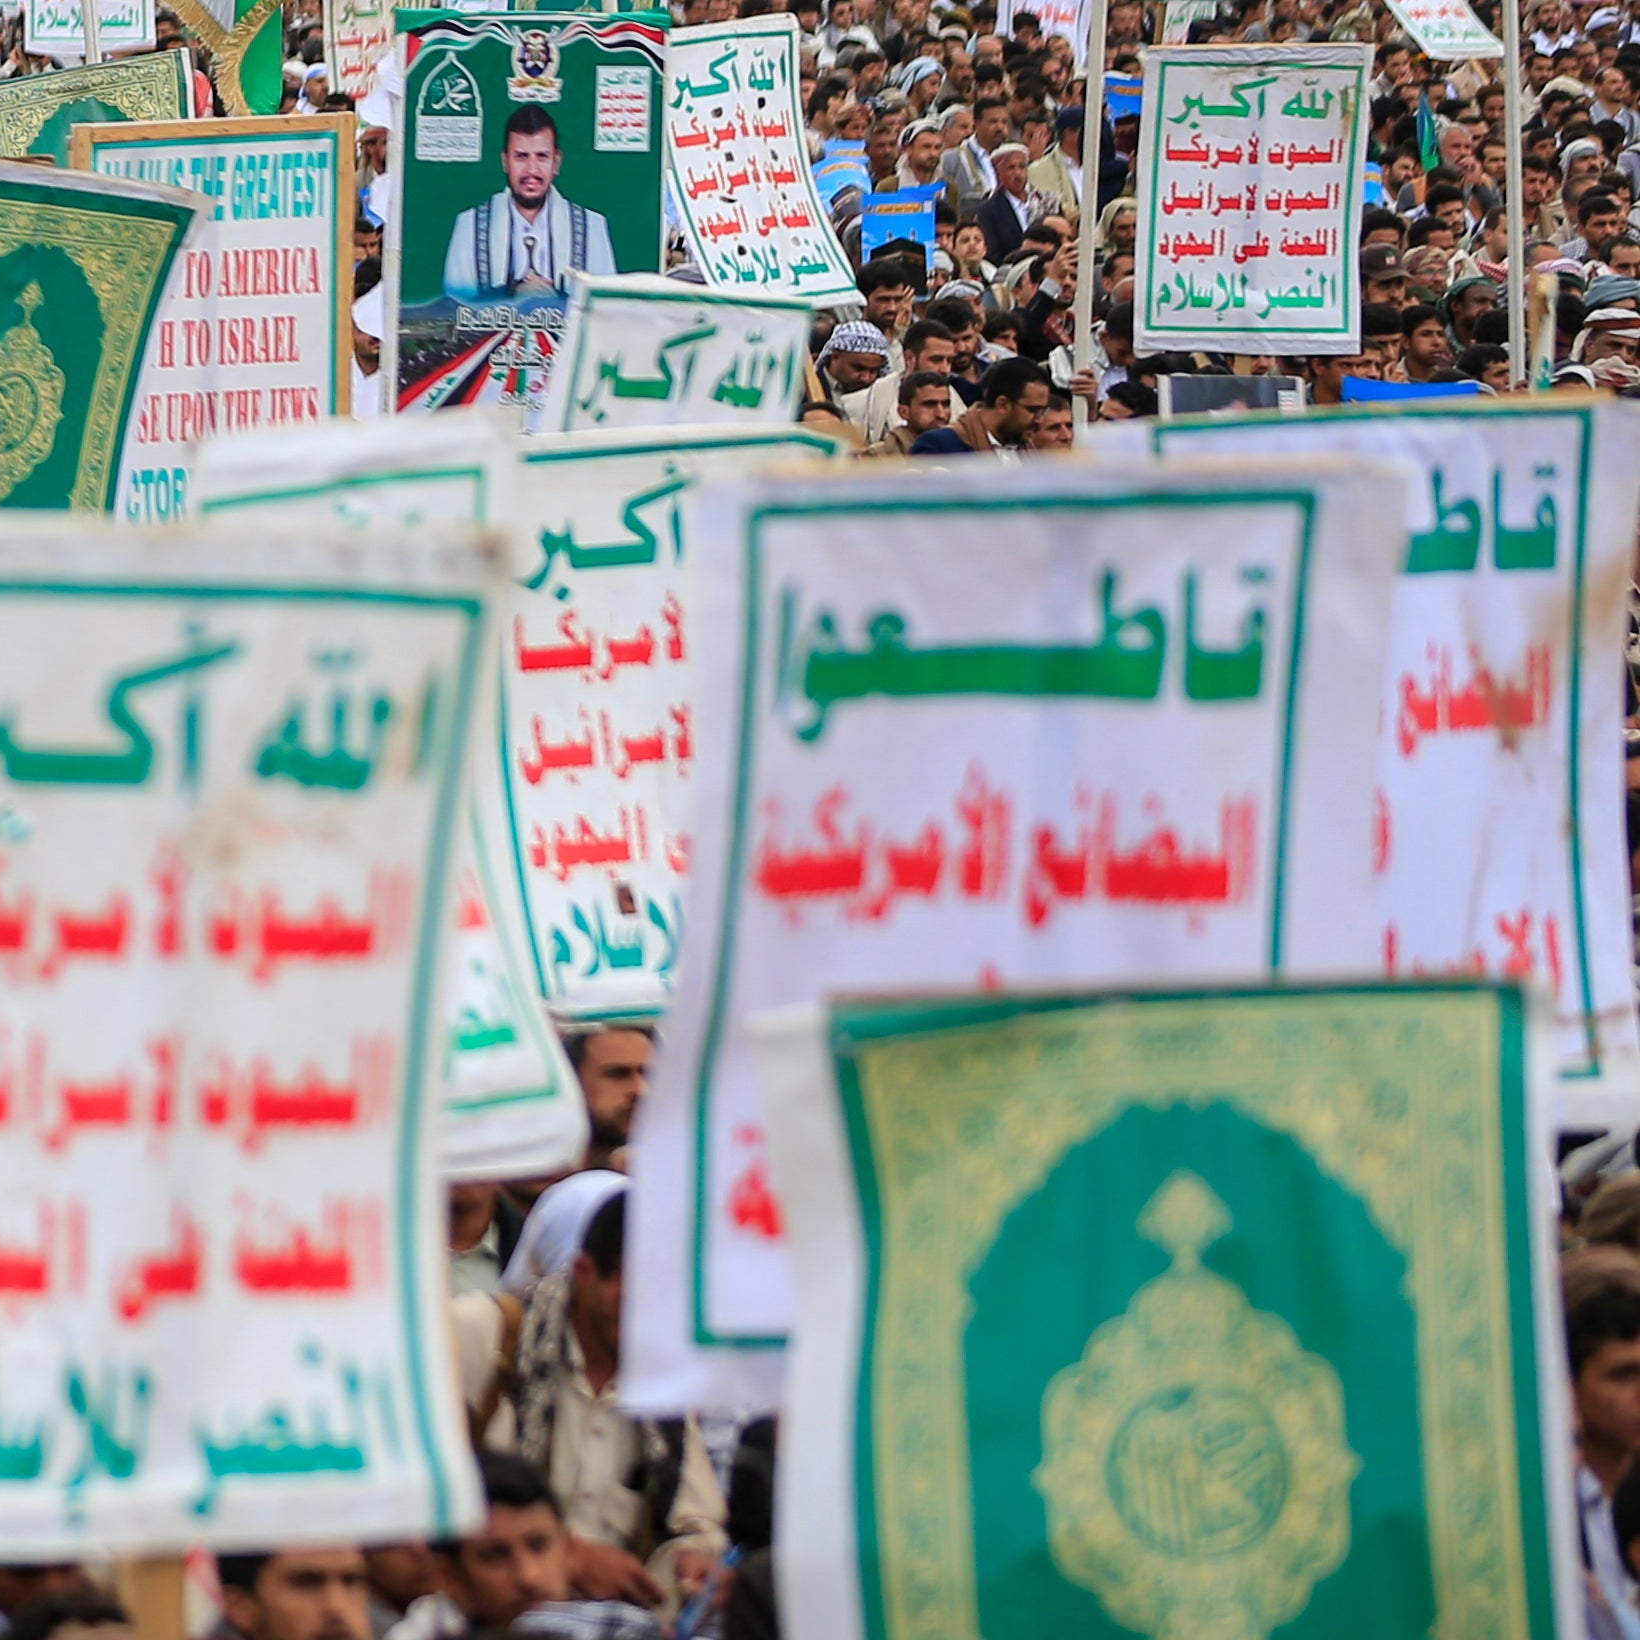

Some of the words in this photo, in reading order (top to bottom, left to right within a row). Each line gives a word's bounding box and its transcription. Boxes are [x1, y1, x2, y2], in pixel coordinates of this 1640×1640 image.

[669, 44, 740, 110] أكبر
[748, 49, 788, 94] الله
[1166, 70, 1277, 130] أكبر
[1282, 77, 1349, 120] الله
[672, 109, 749, 148] لأمريكا
[1164, 130, 1259, 172] لأمريكا
[1267, 135, 1344, 168] الموت
[231, 152, 328, 221] GREATEST
[686, 150, 761, 199] لإسرائيل
[1161, 181, 1257, 219] لإسرائيل
[1264, 181, 1339, 216] الموت
[699, 206, 750, 244] اليهود
[1158, 226, 1225, 264] اليهود
[1233, 227, 1270, 265] على
[1279, 224, 1337, 259] اللعنة
[184, 251, 212, 299] TO
[217, 247, 321, 298] AMERICA
[716, 241, 782, 286] للإسلام
[789, 239, 830, 286] النصر
[1257, 261, 1337, 320] النصر
[1155, 271, 1248, 324] للإسلام
[184, 320, 212, 366] TO
[218, 316, 299, 365] ISRAEL
[574, 310, 718, 424] أكبر
[709, 332, 799, 413] الله
[165, 390, 218, 442] UPON
[224, 389, 262, 430] THE
[267, 387, 319, 426] JEWS
[515, 459, 698, 601] أكبر
[512, 590, 688, 685] لأمريكا
[771, 563, 1275, 748] قاطعوا
[254, 640, 443, 791] الله
[521, 699, 696, 785] لإسرائيل
[531, 802, 646, 882] اليهود
[747, 759, 1020, 927] الأمريكية
[1021, 771, 1261, 935] البضائع
[209, 862, 415, 988] الموت
[199, 1032, 395, 1159] الموت
[116, 1197, 204, 1325] على
[232, 1185, 388, 1304] اللعنة
[182, 1330, 407, 1520] النصر
